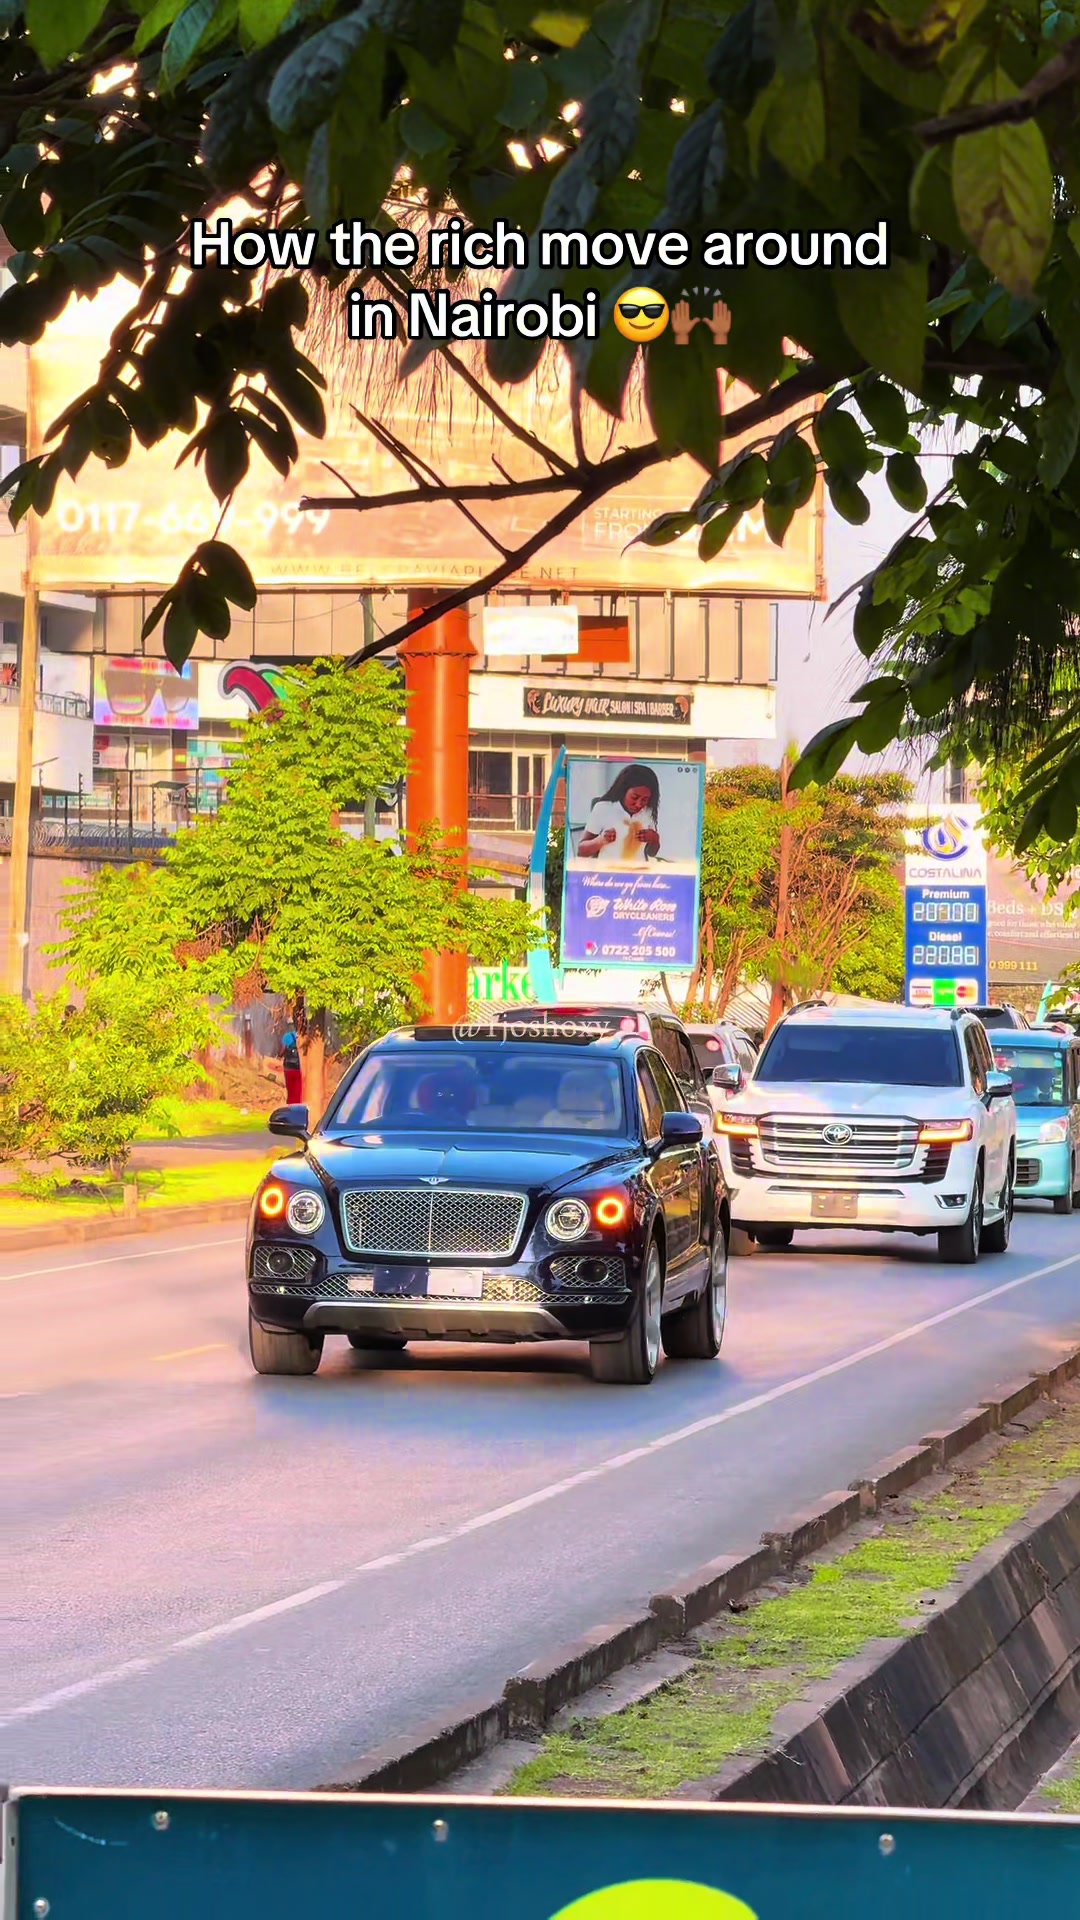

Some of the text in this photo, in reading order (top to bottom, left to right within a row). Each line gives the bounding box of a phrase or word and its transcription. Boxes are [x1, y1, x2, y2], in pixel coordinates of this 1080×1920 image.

[650, 703, 674, 717] BARBER
[909, 867, 982, 878] COSTALINA
[922, 889, 970, 899] Premium
[613, 898, 648, 911] White
[988, 900, 1024, 915] Beds
[613, 911, 675, 921] DRYCLEANERS
[929, 931, 962, 941] Diesel
[602, 945, 676, 957] 0722 205 500
[997, 961, 1018, 971] 999
[1020, 962, 1039, 971] 111
